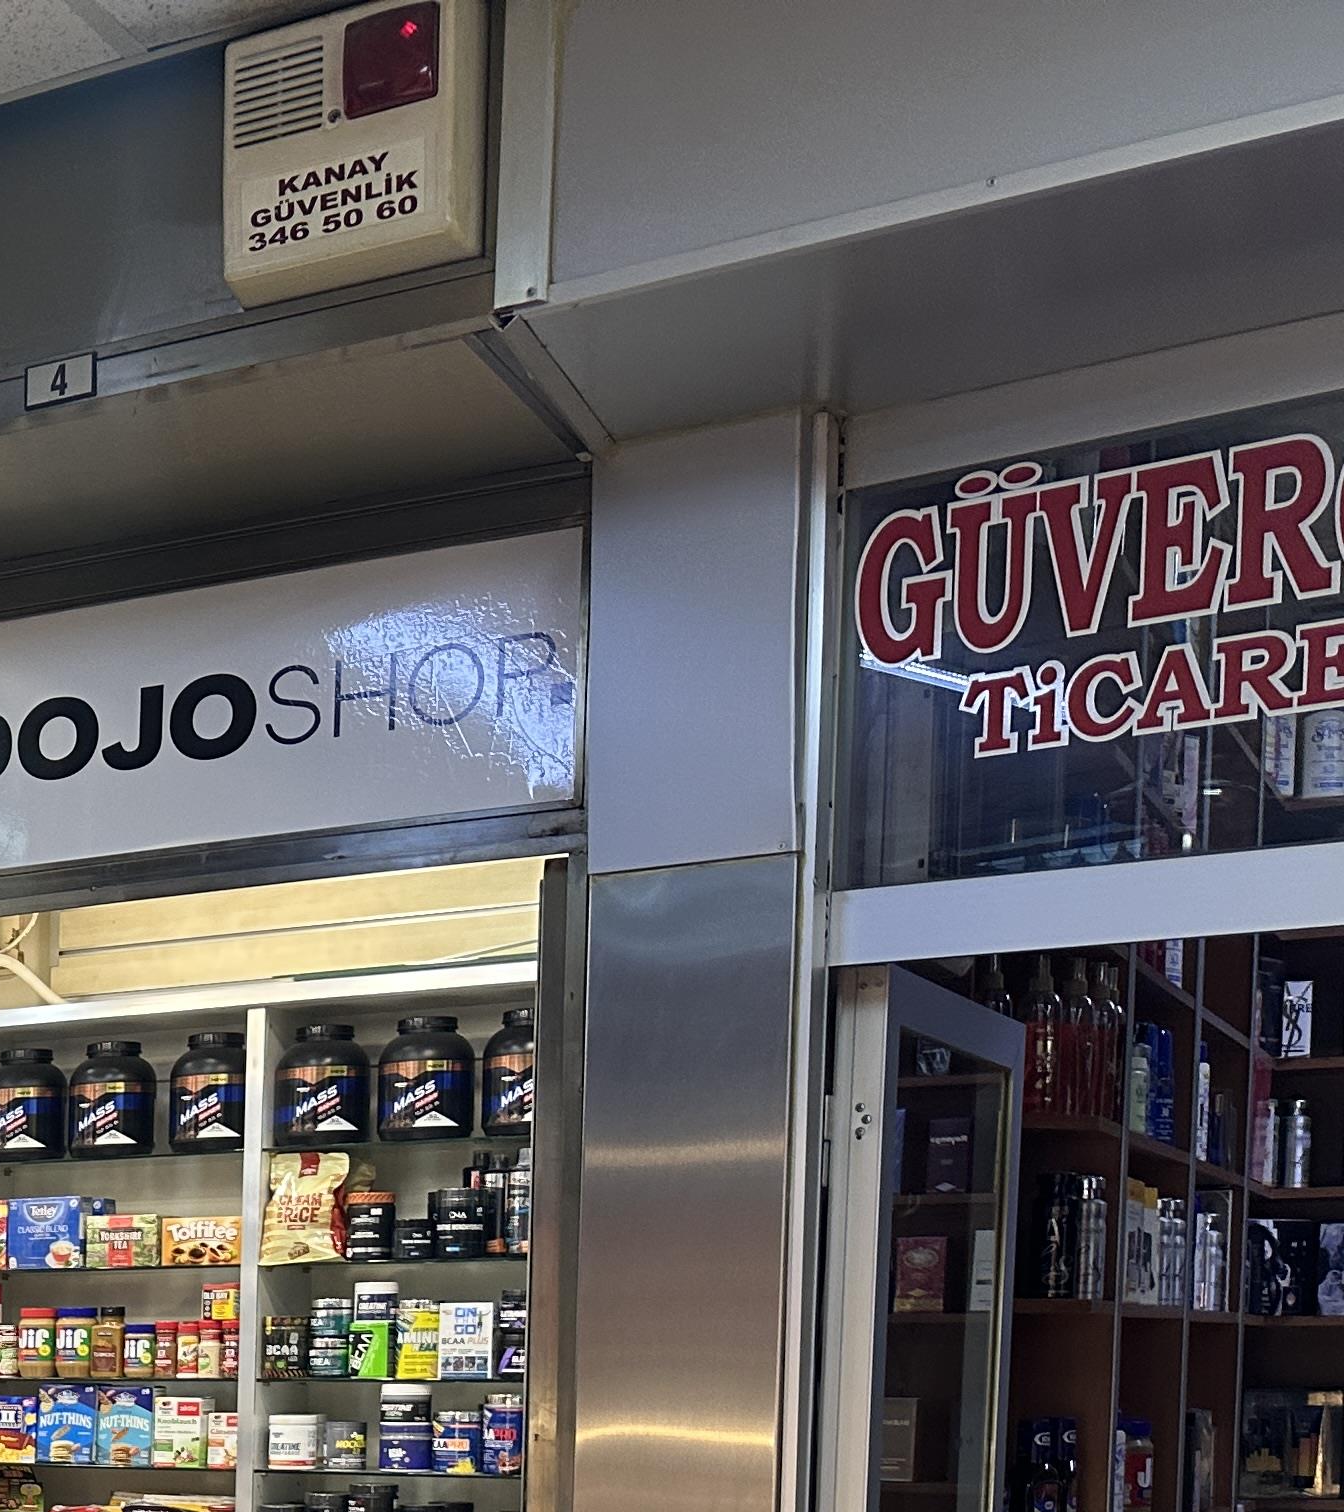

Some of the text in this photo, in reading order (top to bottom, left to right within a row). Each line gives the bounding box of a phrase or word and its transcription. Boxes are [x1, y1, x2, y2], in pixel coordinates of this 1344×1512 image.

[278, 152, 389, 197] KANAY
[250, 170, 418, 228] GÜVENLİK
[249, 195, 418, 252] 346 50 60
[50, 364, 69, 396] 4
[855, 433, 1344, 665] GÜVER
[180, 1093, 218, 1125] MASS
[296, 1085, 338, 1118] MASS
[394, 1080, 436, 1114] MASS
[78, 1101, 115, 1132] MASS
[113, 1239, 128, 1250] TEA
[167, 1220, 238, 1242] Toffifee
[19, 1329, 49, 1350] Jif
[124, 1340, 150, 1358] Jif
[266, 1344, 298, 1356] BCAA
[441, 1336, 465, 1345] BCAA
[39, 1415, 92, 1430] NUT-THINS
[99, 1415, 150, 1432] NUT-THINS
